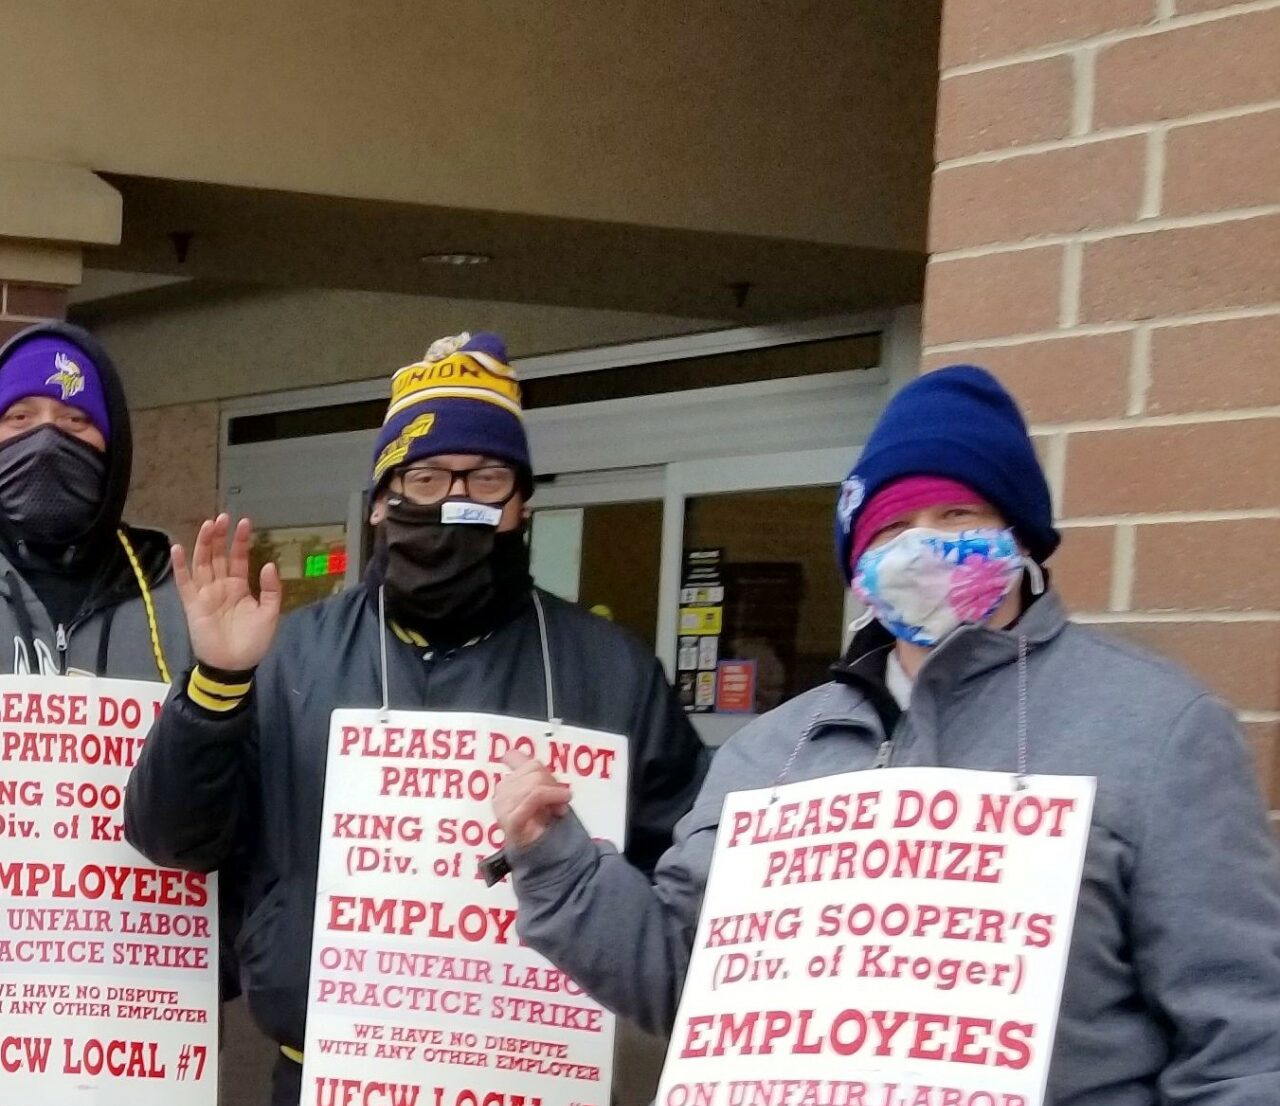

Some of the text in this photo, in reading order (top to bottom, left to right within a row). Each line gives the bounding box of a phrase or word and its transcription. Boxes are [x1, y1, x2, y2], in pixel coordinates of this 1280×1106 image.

[98, 697, 141, 729] DO
[2, 732, 143, 767] PATRONI
[340, 726, 476, 760] PLEASE
[548, 741, 616, 779] NOT
[53, 814, 79, 839] of
[333, 814, 423, 841] KING
[726, 789, 1076, 848] PLEASE DO NOT
[346, 847, 417, 877] (Div.
[433, 851, 461, 875] of
[762, 840, 1005, 888] PATRONIZE
[7, 909, 113, 933] UNFAIR
[120, 912, 211, 938] LABOR
[327, 896, 519, 946] EMPLOY
[704, 903, 1056, 949] KING SOOPER'S
[113, 944, 208, 969] STRIKE
[320, 947, 591, 997] ON UNFAIR LABO
[711, 945, 1027, 995] (Div. of Kroger)
[9, 1001, 47, 1014] ANY
[52, 1003, 111, 1018] OTHER
[117, 1005, 208, 1023] EMPLOYER
[23, 984, 70, 999] HAVE
[76, 985, 100, 1000] NO
[106, 987, 179, 1005] DISPUTE
[318, 981, 603, 1033] PRACTICE STRIKE
[63, 1038, 165, 1078] LOCAL
[176, 1043, 207, 1082] #7
[353, 1024, 569, 1059] WE HAVE NO DISPUTE
[679, 1009, 1035, 1070] EMPLOYEES
[318, 1040, 600, 1081] WITH ANY OTHER EMPLOYER
